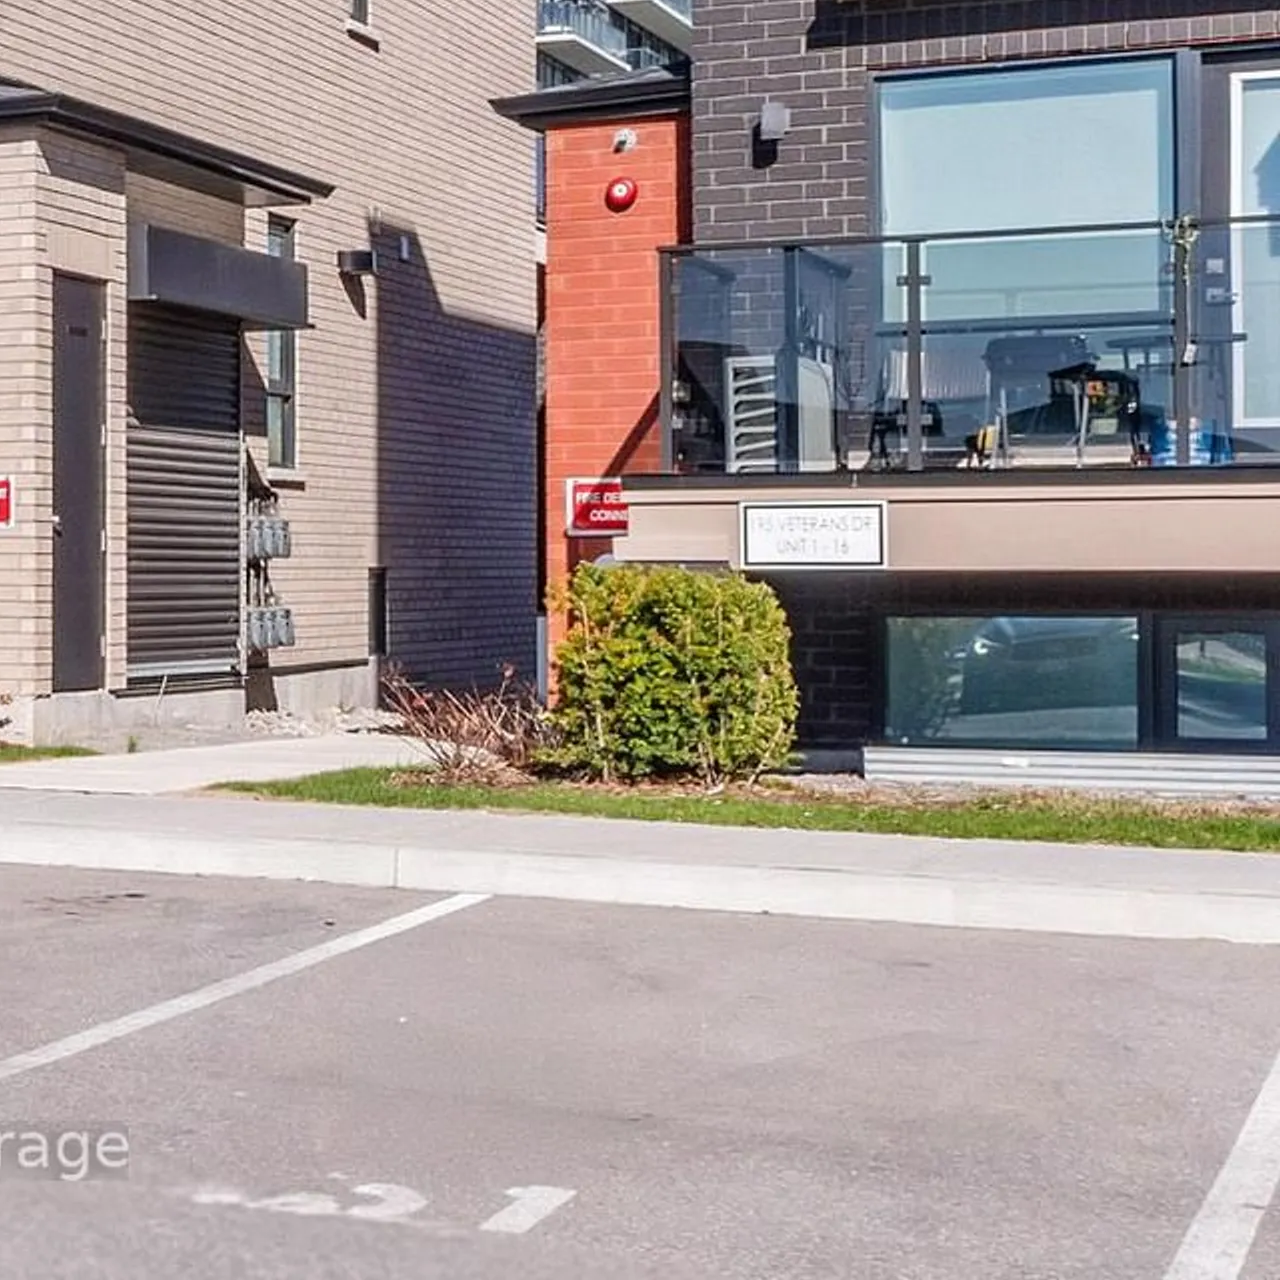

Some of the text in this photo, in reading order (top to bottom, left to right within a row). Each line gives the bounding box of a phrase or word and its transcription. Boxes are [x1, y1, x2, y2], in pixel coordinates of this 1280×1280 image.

[576, 492, 600, 503] FIRE
[776, 515, 849, 532] VETERANS
[777, 538, 807, 554] UNIT
